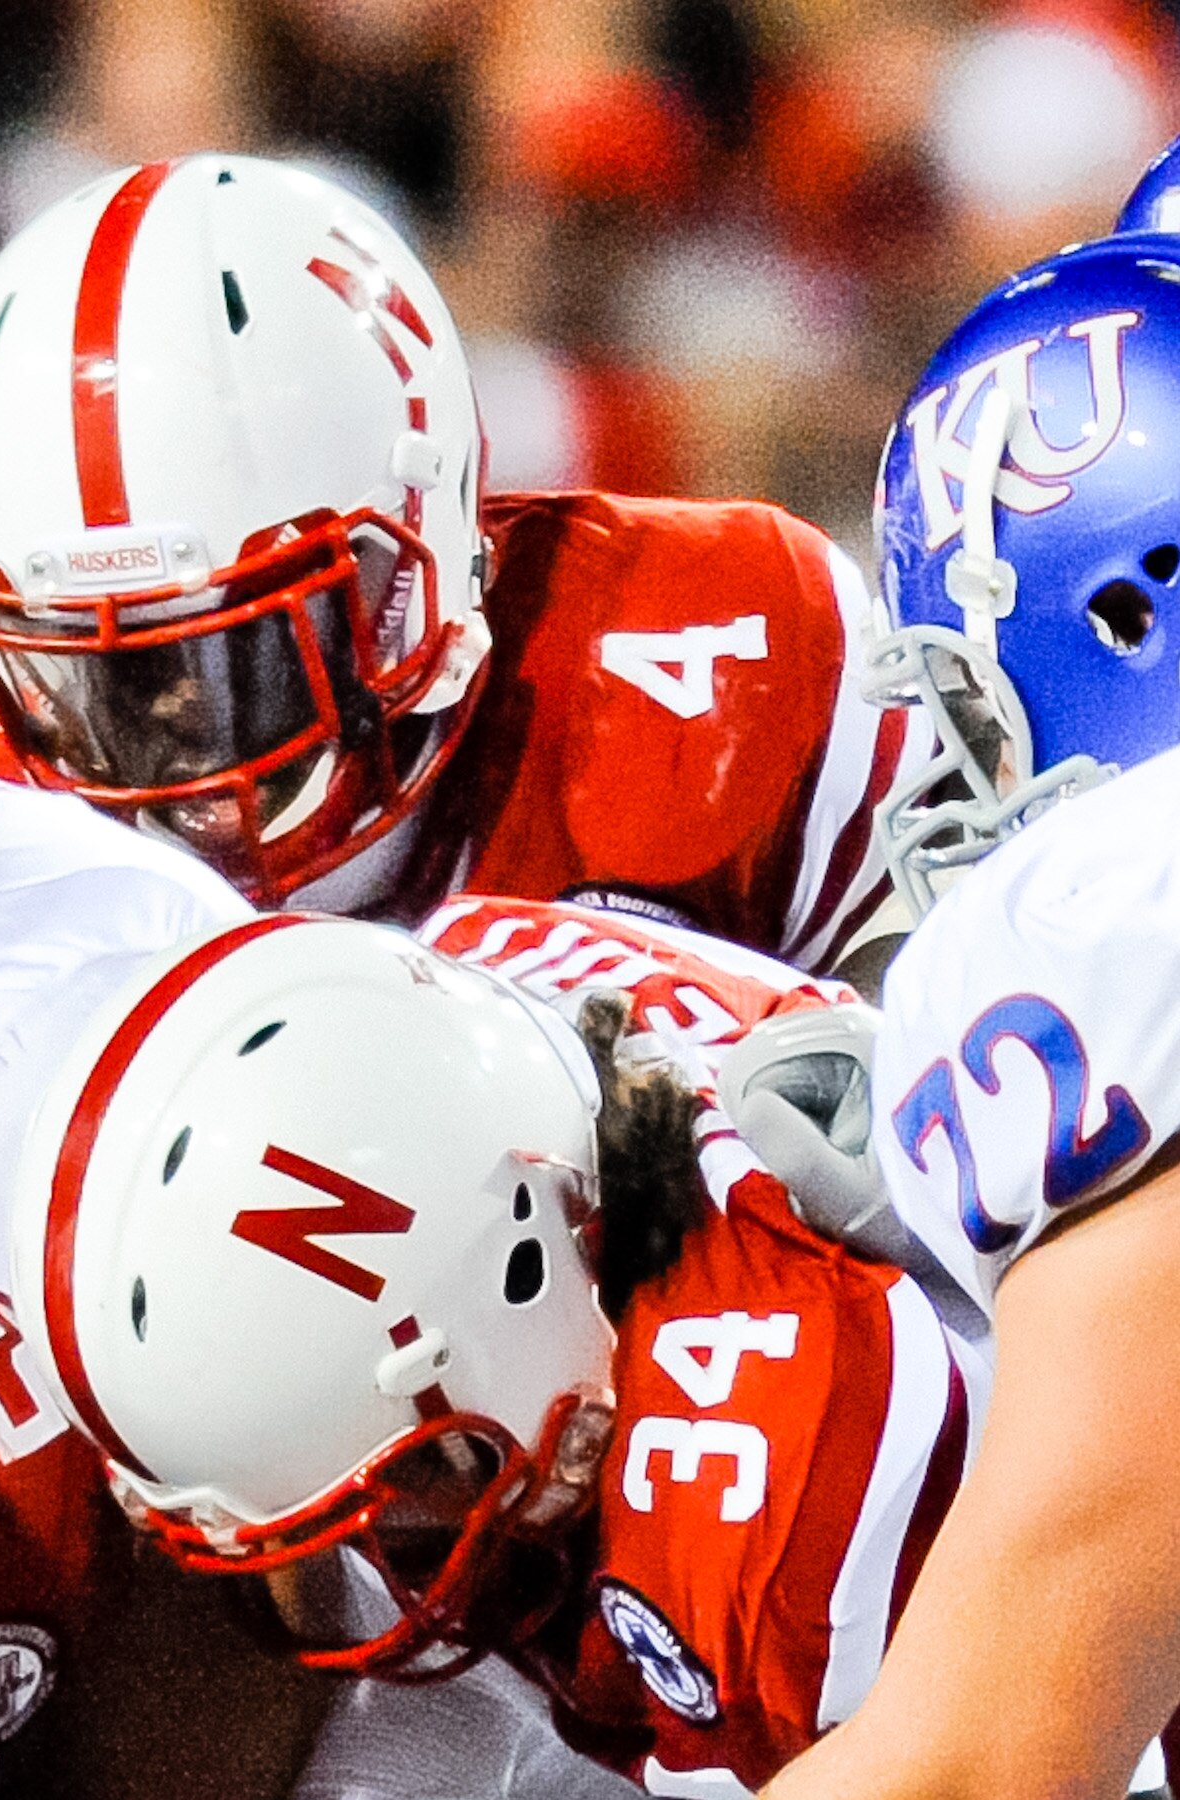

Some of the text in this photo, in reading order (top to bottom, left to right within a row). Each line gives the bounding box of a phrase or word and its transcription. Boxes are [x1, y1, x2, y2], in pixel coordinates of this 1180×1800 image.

[905, 310, 1142, 553] KU
[69, 545, 159, 573] HUSKERS
[600, 613, 769, 720] 4
[891, 992, 1153, 1256] 72
[230, 1143, 417, 1303] N
[622, 1309, 801, 1523] 34
